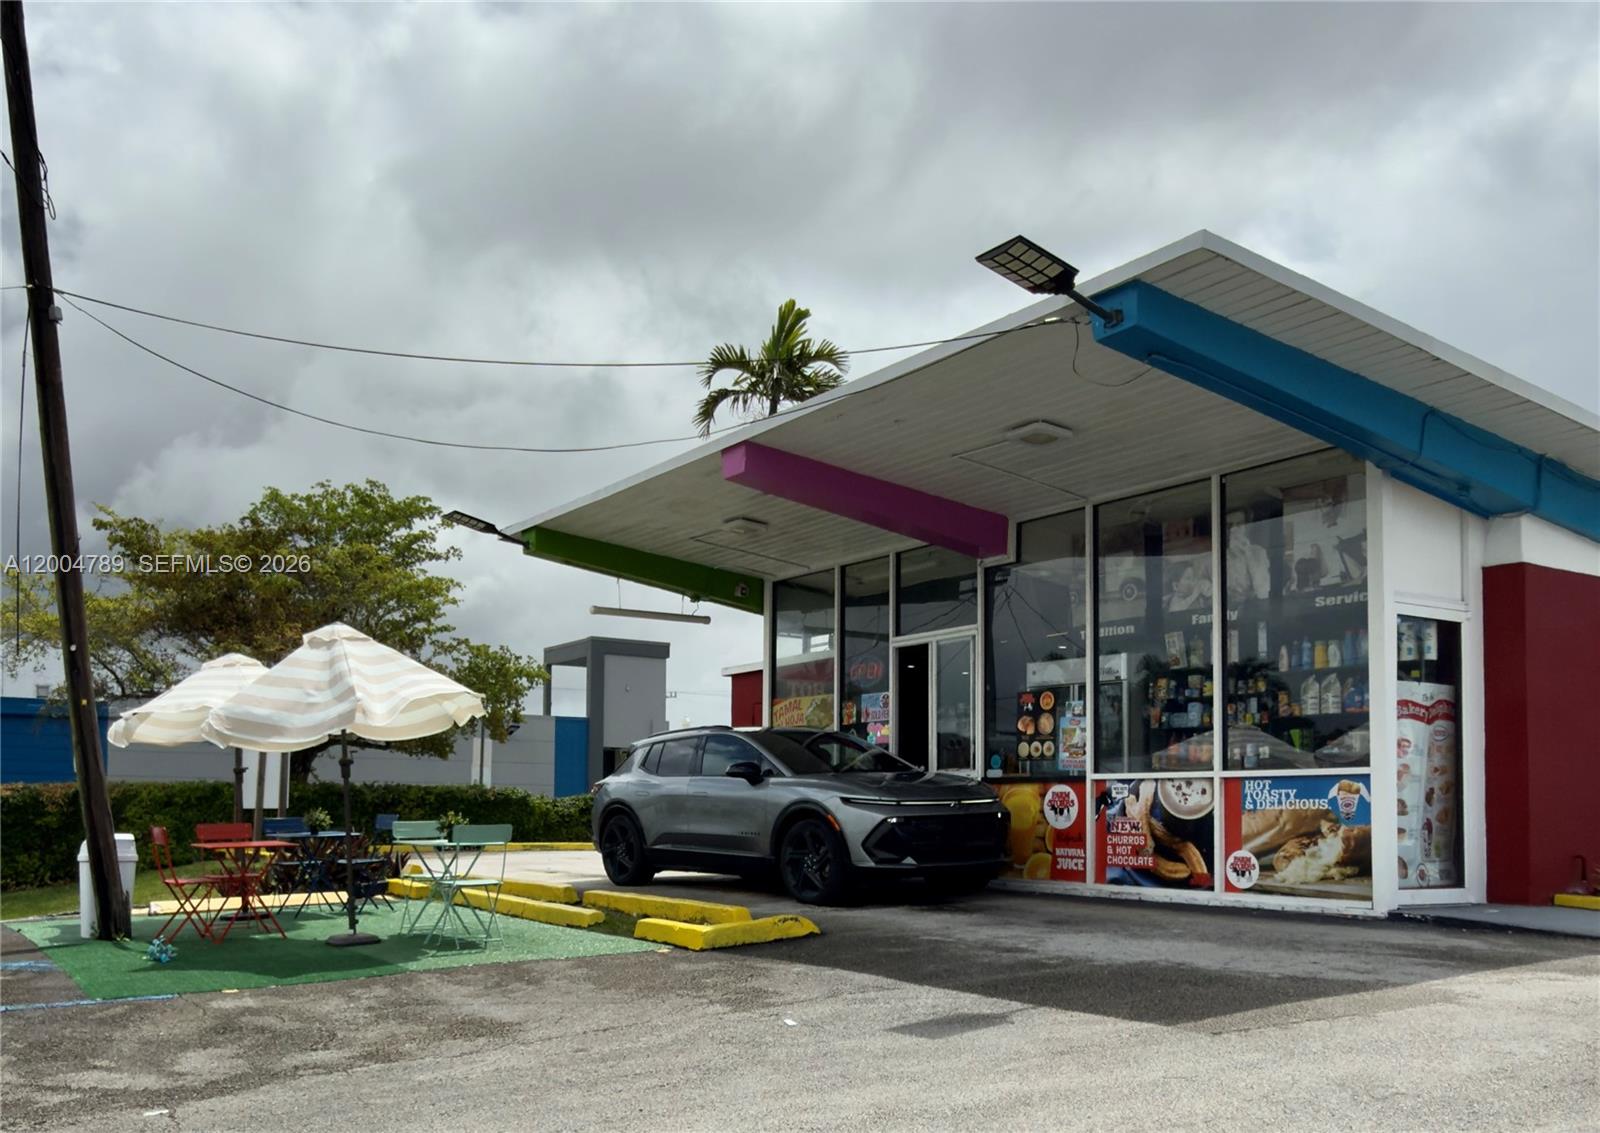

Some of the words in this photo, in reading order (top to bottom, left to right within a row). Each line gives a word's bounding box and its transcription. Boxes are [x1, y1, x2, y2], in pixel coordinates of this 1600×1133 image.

[850, 661, 883, 678] OPEN
[773, 698, 802, 721] TAMAL
[1244, 779, 1271, 791] HOT
[1246, 788, 1297, 800] TOASTY
[1245, 799, 1254, 810] &
[1256, 798, 1333, 810] DELICIOUS.
[1110, 821, 1142, 833] NEW
[1107, 835, 1145, 845] CHURROS
[1055, 848, 1086, 857] NATURAL
[1106, 845, 1114, 855] &
[1116, 845, 1132, 855] HOT
[1056, 858, 1085, 871] JUICE
[1106, 855, 1153, 866] CHOCOLATE
